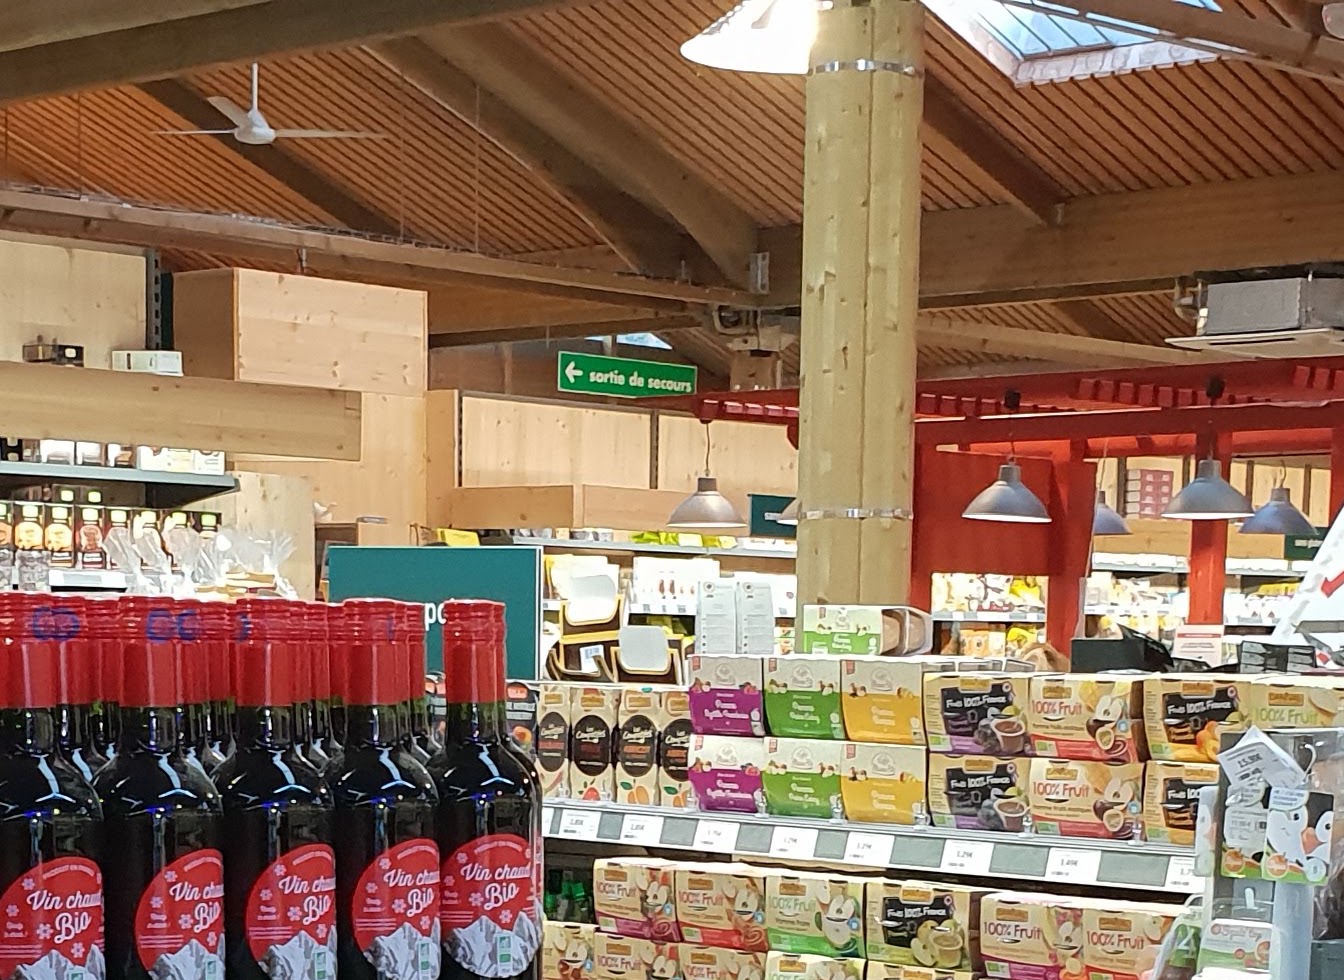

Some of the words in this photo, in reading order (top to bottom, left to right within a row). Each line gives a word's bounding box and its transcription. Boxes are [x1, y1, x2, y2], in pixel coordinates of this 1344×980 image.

[589, 370, 625, 386] sortie
[629, 371, 644, 387] de
[648, 378, 692, 392] secours
[1031, 700, 1058, 715] 100%
[1059, 702, 1082, 715] Fruit
[1254, 708, 1285, 722] 100%
[1288, 709, 1318, 723] Fruit
[1032, 782, 1062, 797] 100%
[1065, 784, 1089, 798] Fruit
[383, 869, 414, 887] Vin
[460, 862, 491, 880] Vin
[169, 882, 201, 901] Vin
[279, 875, 310, 894] Vin
[617, 885, 637, 898] Fruit
[26, 890, 63, 910] Vin
[406, 888, 435, 917] Bio
[482, 883, 519, 911] Bio
[679, 891, 701, 903] 100%
[702, 893, 724, 907] Fruit
[793, 898, 816, 912] Fruit
[194, 902, 221, 933] Bio
[303, 895, 332, 925] Bio
[904, 908, 923, 917] 100%
[53, 911, 92, 944] Bio
[983, 921, 1012, 935] 100%
[1014, 925, 1041, 940] Fruit
[1087, 930, 1115, 945] 100%
[1117, 934, 1145, 950] Fruit
[620, 958, 641, 971] Fruit
[705, 968, 727, 980] Fruit
